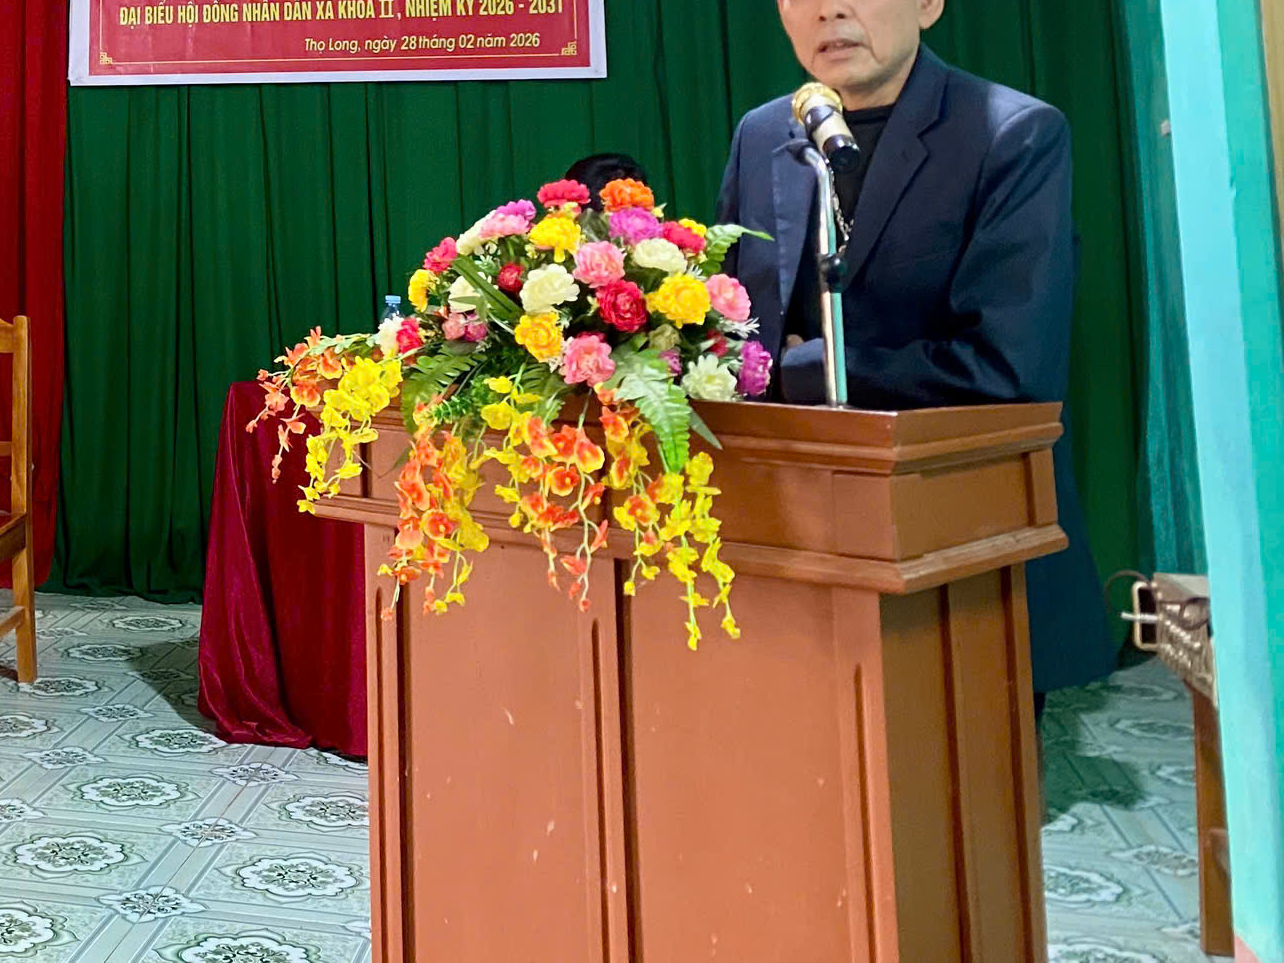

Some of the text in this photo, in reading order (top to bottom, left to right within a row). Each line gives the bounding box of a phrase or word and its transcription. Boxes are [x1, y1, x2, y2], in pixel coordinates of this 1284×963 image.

[119, 6, 141, 29] ĐẠI
[144, 0, 173, 24] BIỂU
[177, 1, 198, 27] HỘI
[242, 0, 280, 21] NHÂN
[304, 33, 541, 54] Thọ Long, ngày 28 tháng 02 năm 2026
